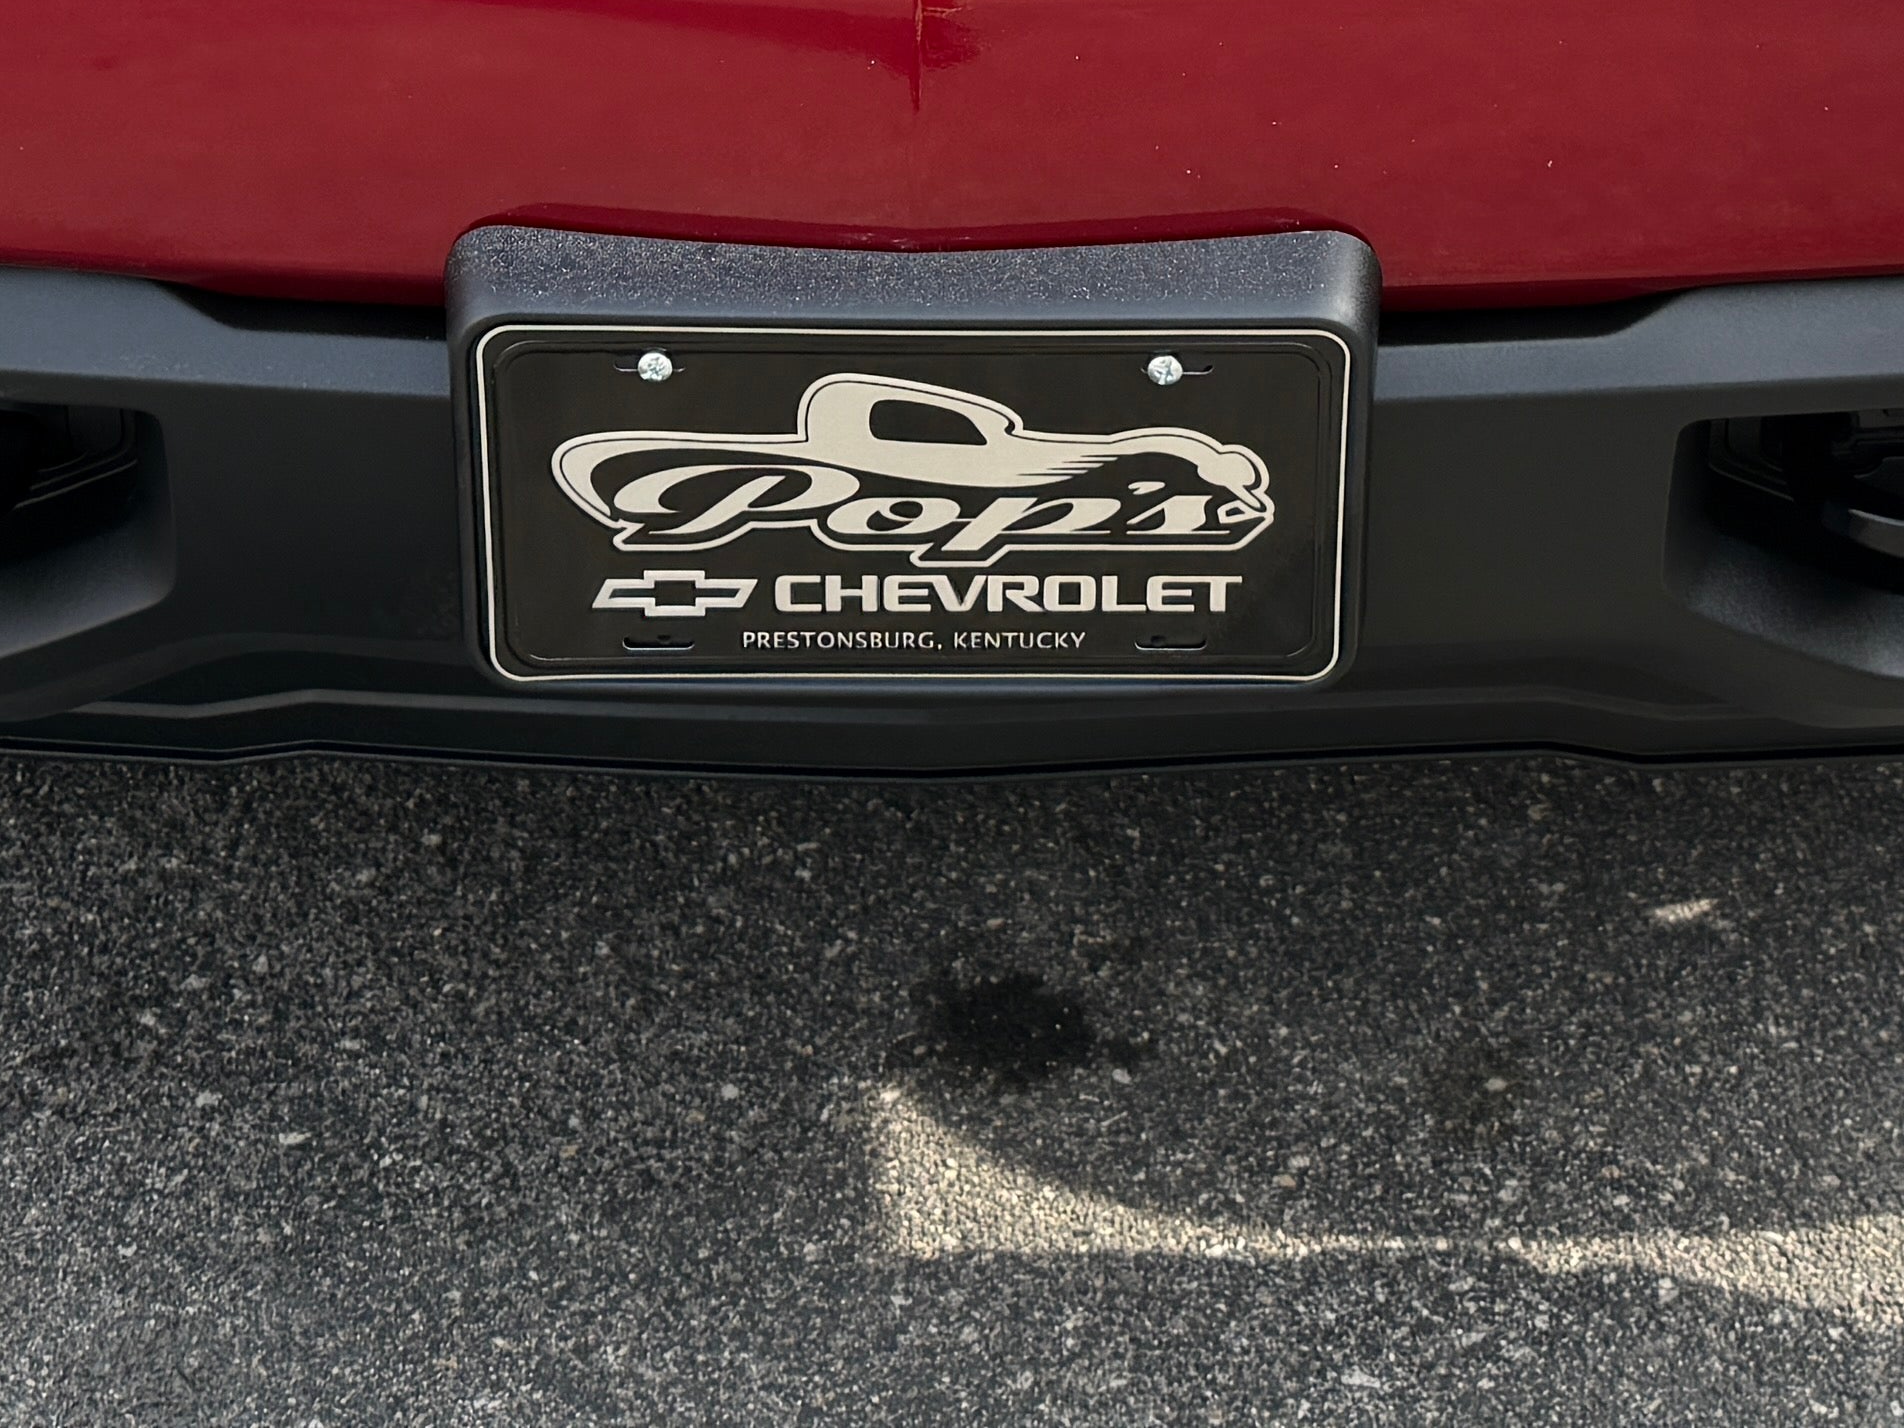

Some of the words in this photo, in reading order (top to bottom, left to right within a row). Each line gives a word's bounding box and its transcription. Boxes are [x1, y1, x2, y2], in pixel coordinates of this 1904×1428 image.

[612, 463, 1234, 552] Pop's
[773, 574, 1244, 614] CHEVROLET
[740, 630, 944, 651] PRESTONSBURG,
[952, 630, 1087, 650] KENTUCKY
